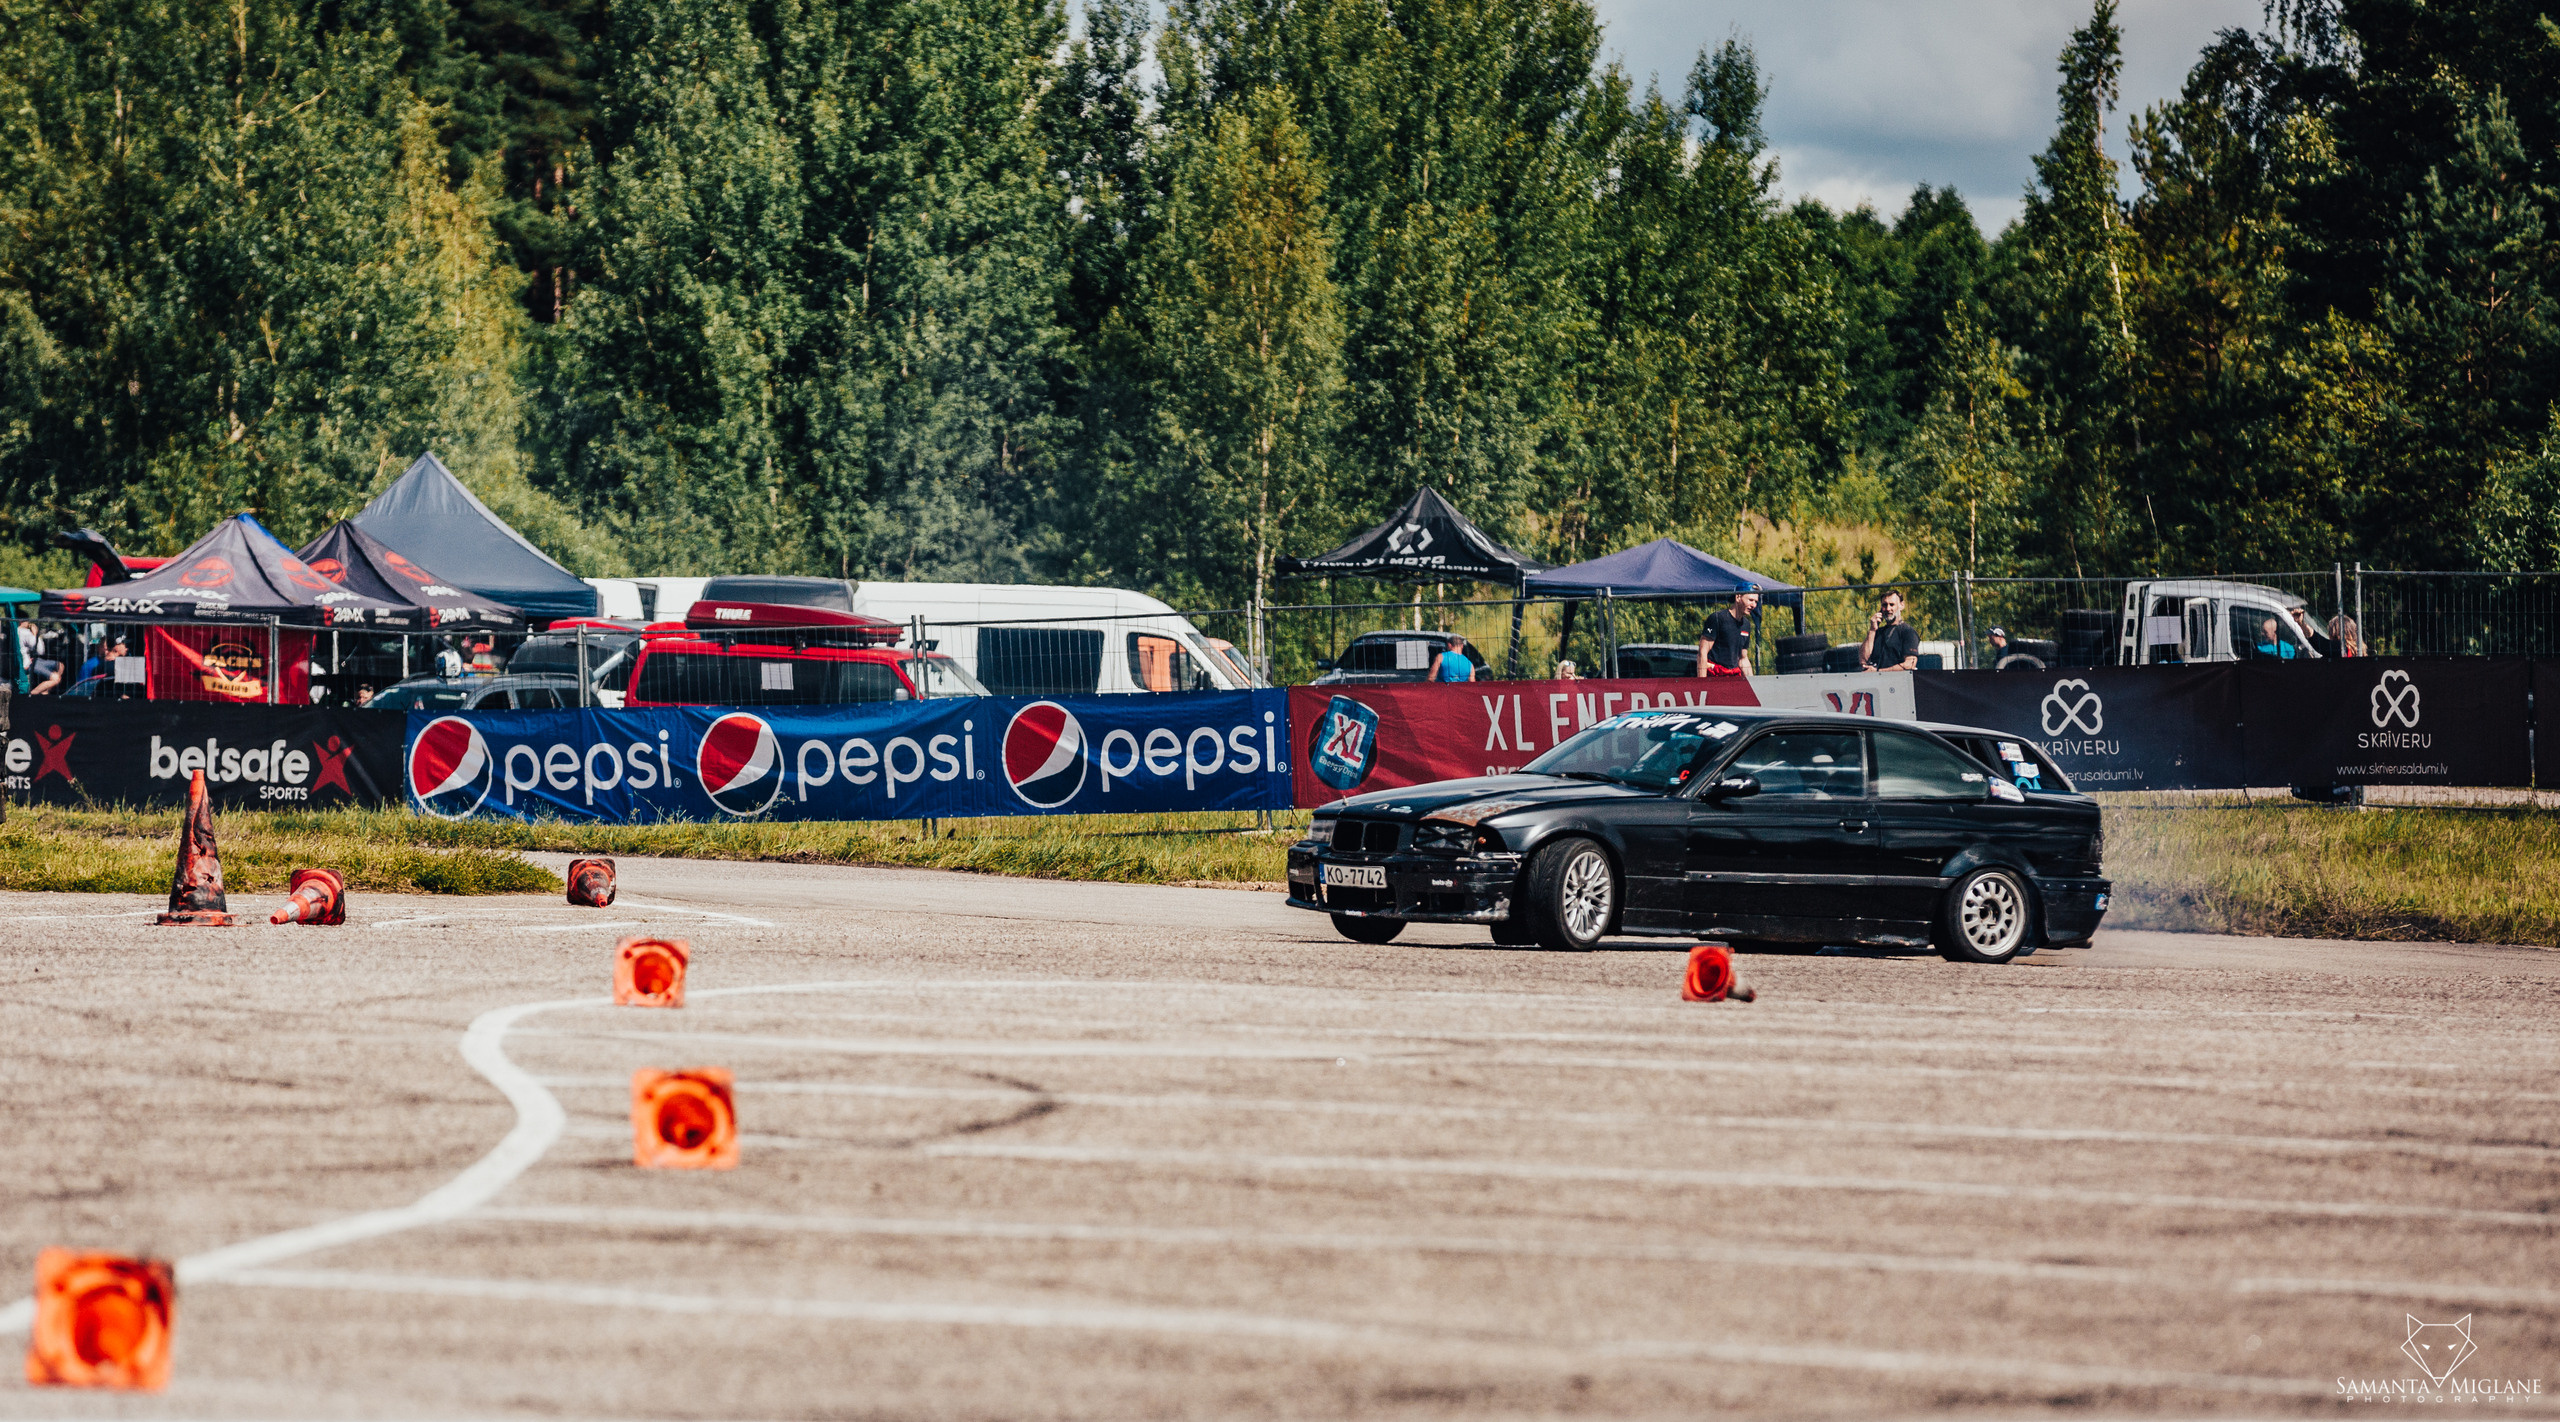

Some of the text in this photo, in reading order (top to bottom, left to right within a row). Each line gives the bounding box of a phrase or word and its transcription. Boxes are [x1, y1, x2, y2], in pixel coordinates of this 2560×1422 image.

[87, 595, 164, 614] 24MX
[715, 608, 752, 620] THULE
[1482, 694, 1534, 751] XL
[1325, 713, 1365, 767] XL
[2357, 730, 2432, 749] SKRĪVERU
[150, 735, 310, 784] betsafe
[798, 719, 974, 802] pepsi
[1100, 711, 1276, 793] pepsi
[505, 729, 672, 806] pepsi
[1318, 755, 1343, 773] Energy
[2336, 762, 2449, 776] www.skriverusaldumi.lv
[260, 785, 308, 801] SPORTS
[1326, 867, 1384, 886] KO-7742
